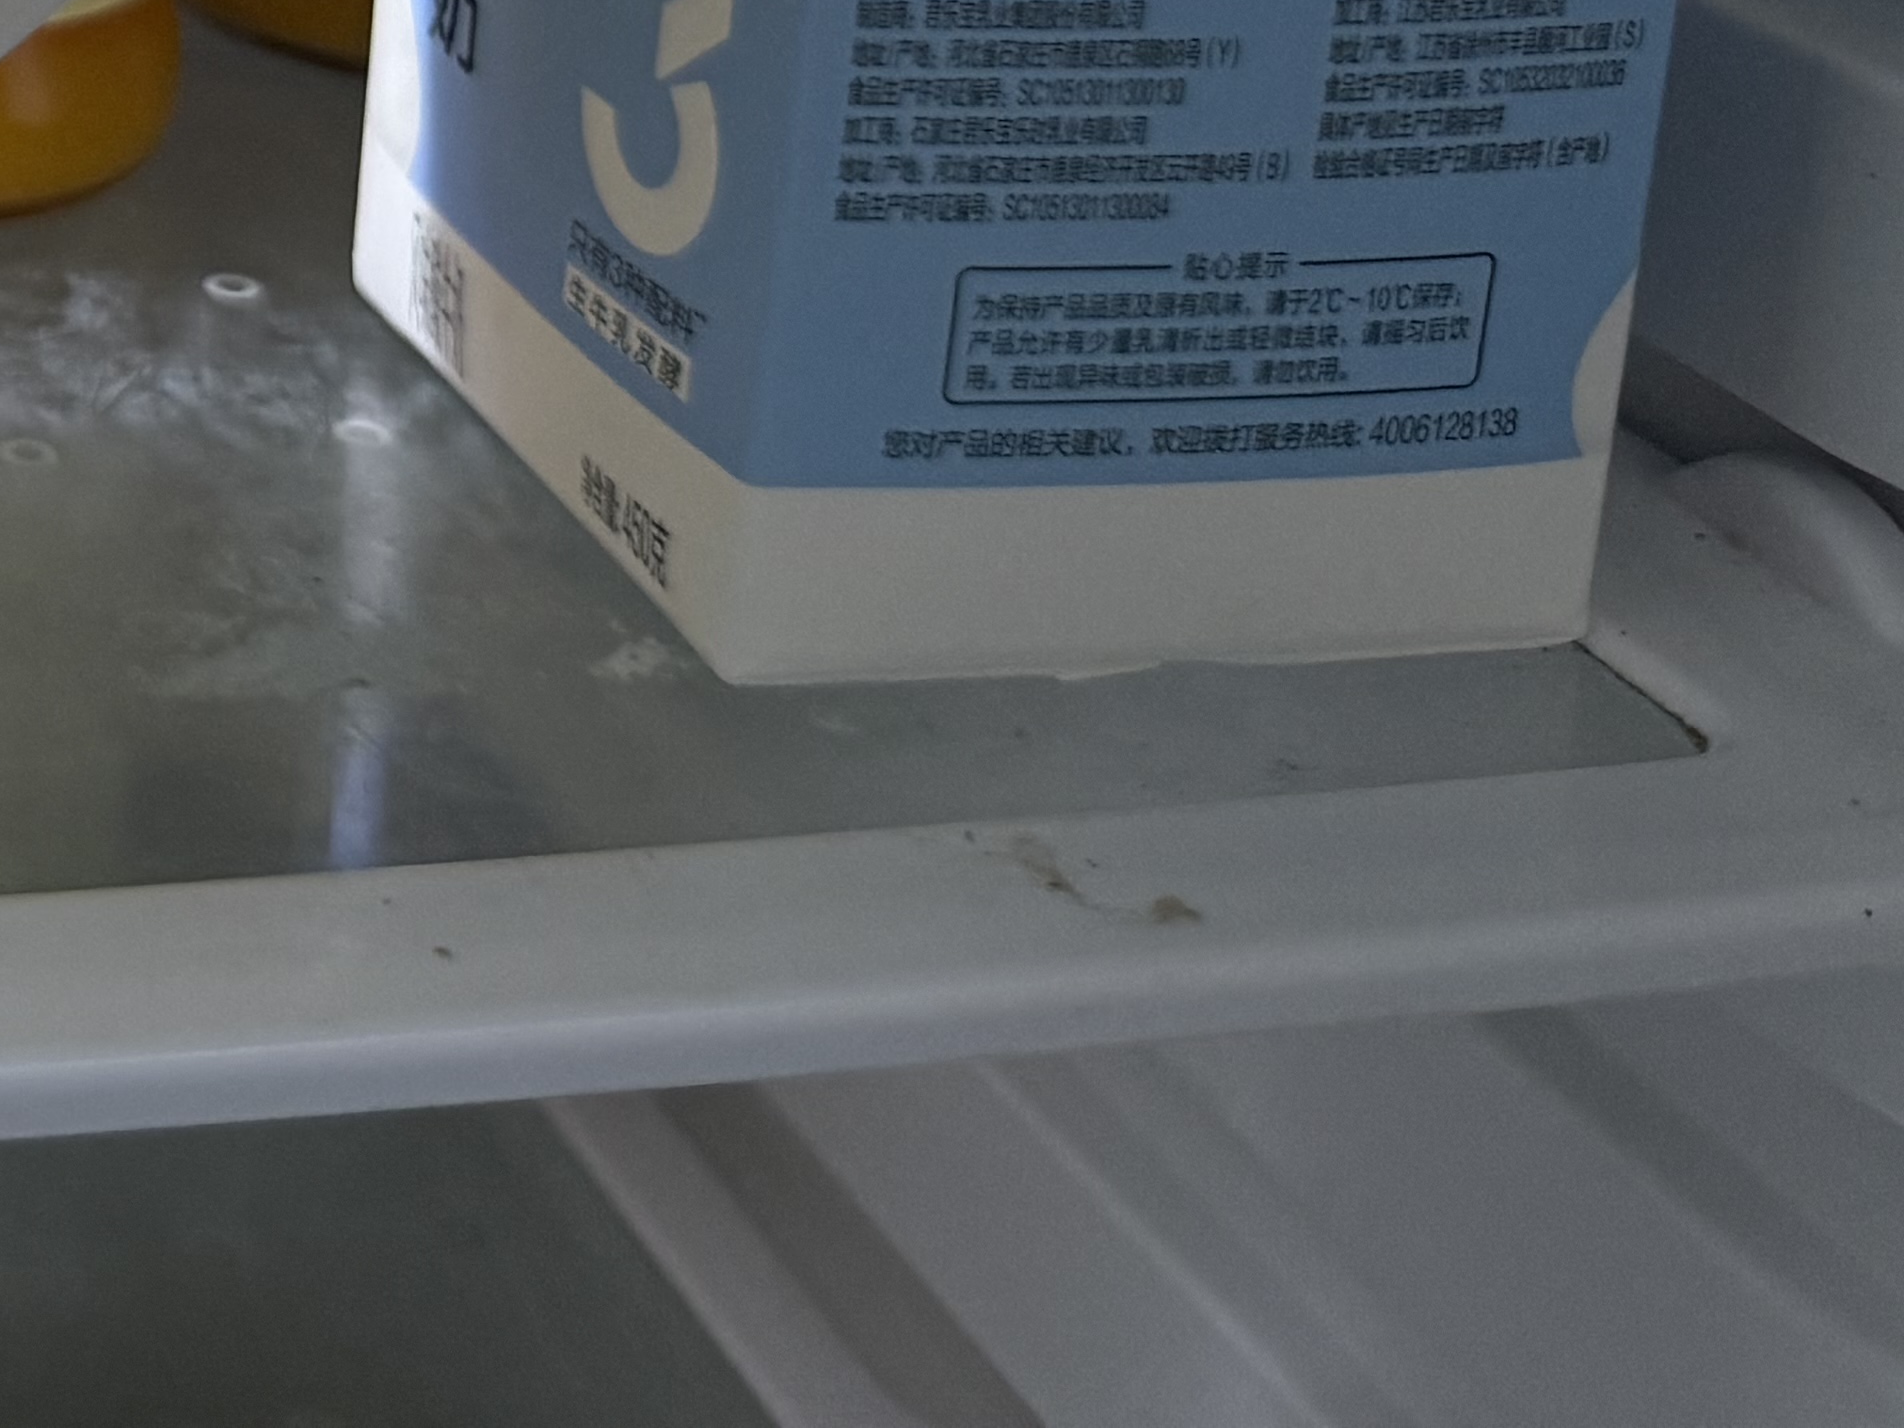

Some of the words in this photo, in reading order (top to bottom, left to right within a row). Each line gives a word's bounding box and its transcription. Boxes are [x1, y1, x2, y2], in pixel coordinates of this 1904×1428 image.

[1183, 250, 1291, 282] 贴心提示
[566, 272, 686, 394] 生牛乳发酵
